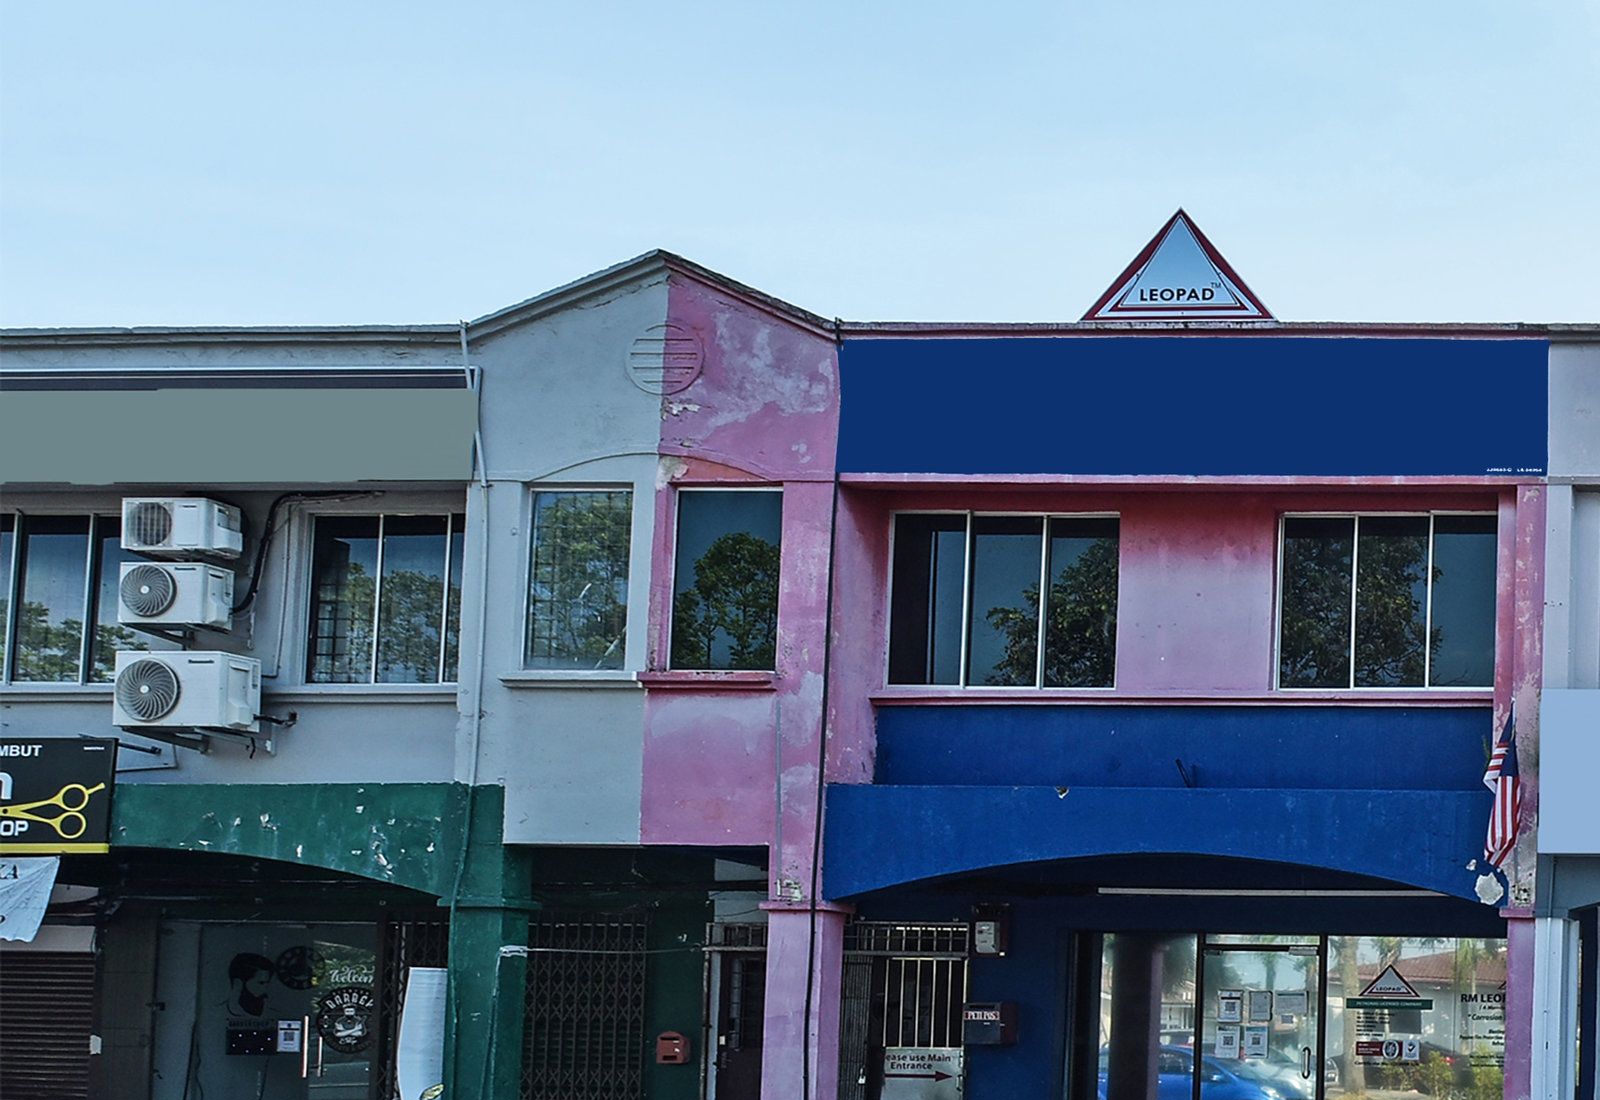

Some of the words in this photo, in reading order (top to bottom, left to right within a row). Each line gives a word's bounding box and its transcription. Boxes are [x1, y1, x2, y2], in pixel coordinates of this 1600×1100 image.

[1140, 288, 1215, 301] LEOPAD
[1461, 994, 1478, 1003] RM
[1481, 994, 1506, 1003] LEO
[928, 1054, 951, 1062] Main
